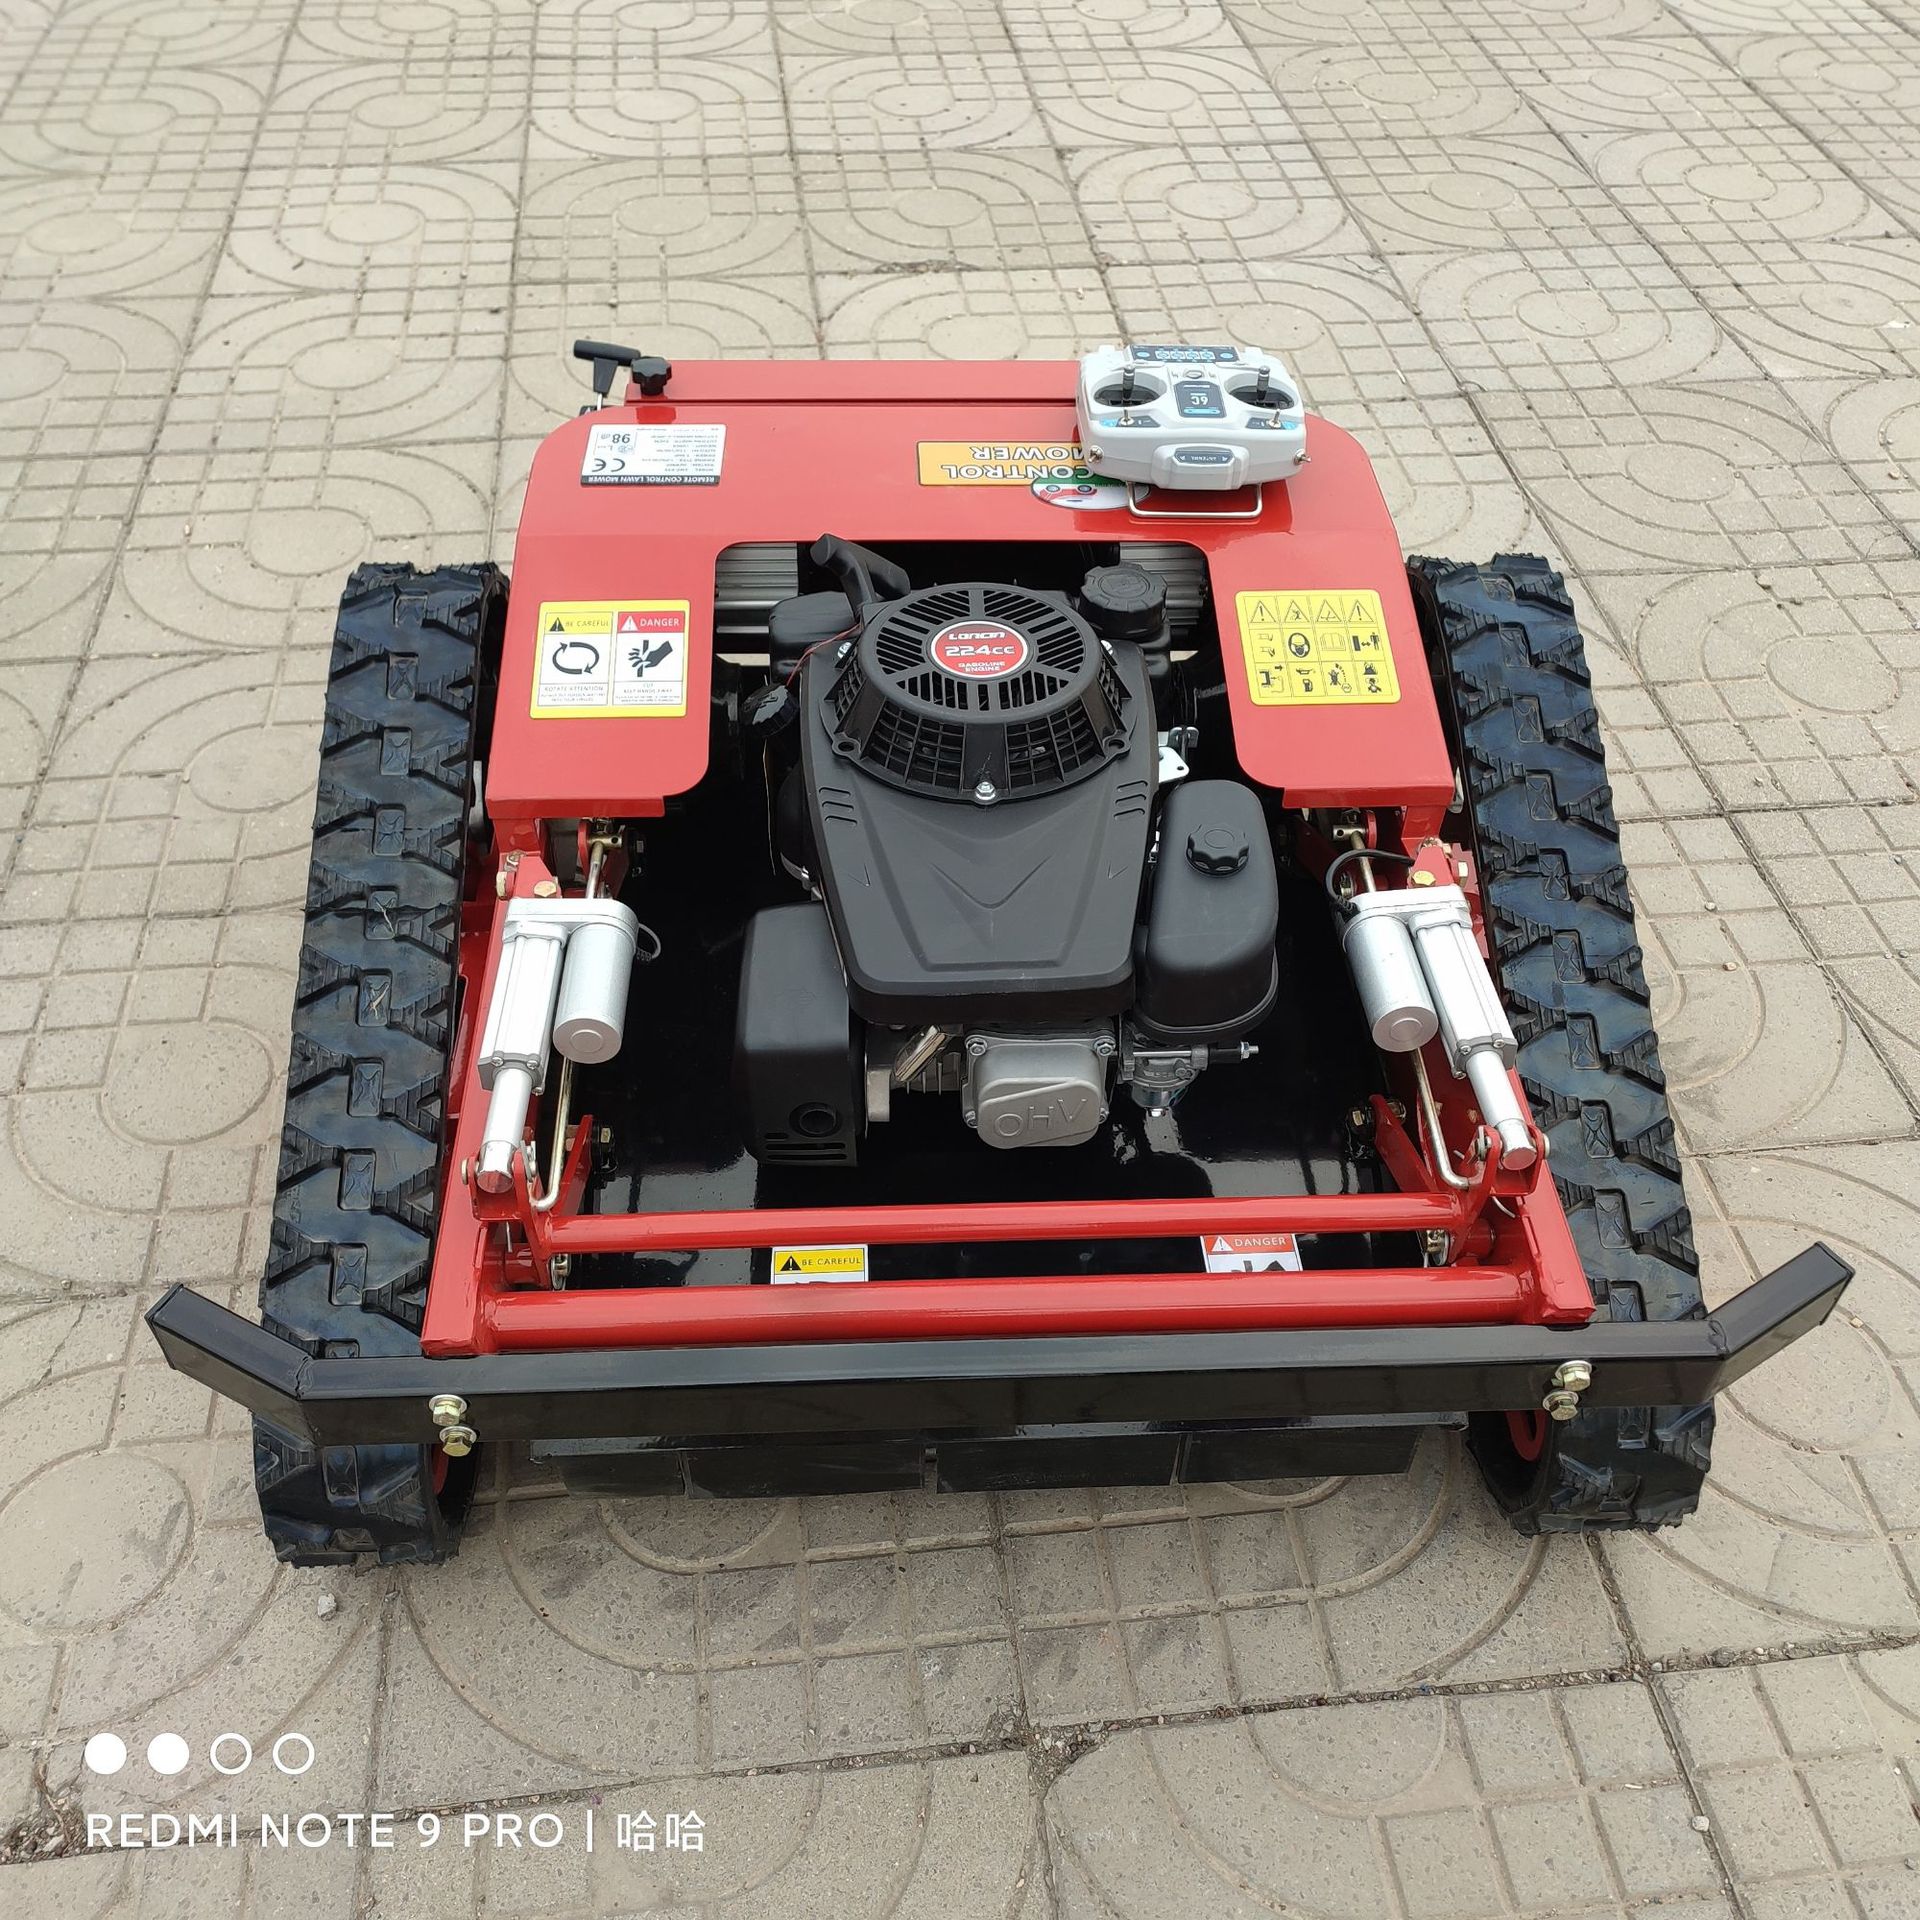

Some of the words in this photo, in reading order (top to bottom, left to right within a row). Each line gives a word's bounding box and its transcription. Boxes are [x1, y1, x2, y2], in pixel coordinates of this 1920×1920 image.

[612, 433, 631, 444] 98
[940, 464, 1091, 480] CONTROL
[640, 617, 680, 627] DANGER
[995, 1098, 1087, 1137] OHV
[1234, 1237, 1287, 1247] DANGER
[817, 1257, 861, 1266] CAREFUL
